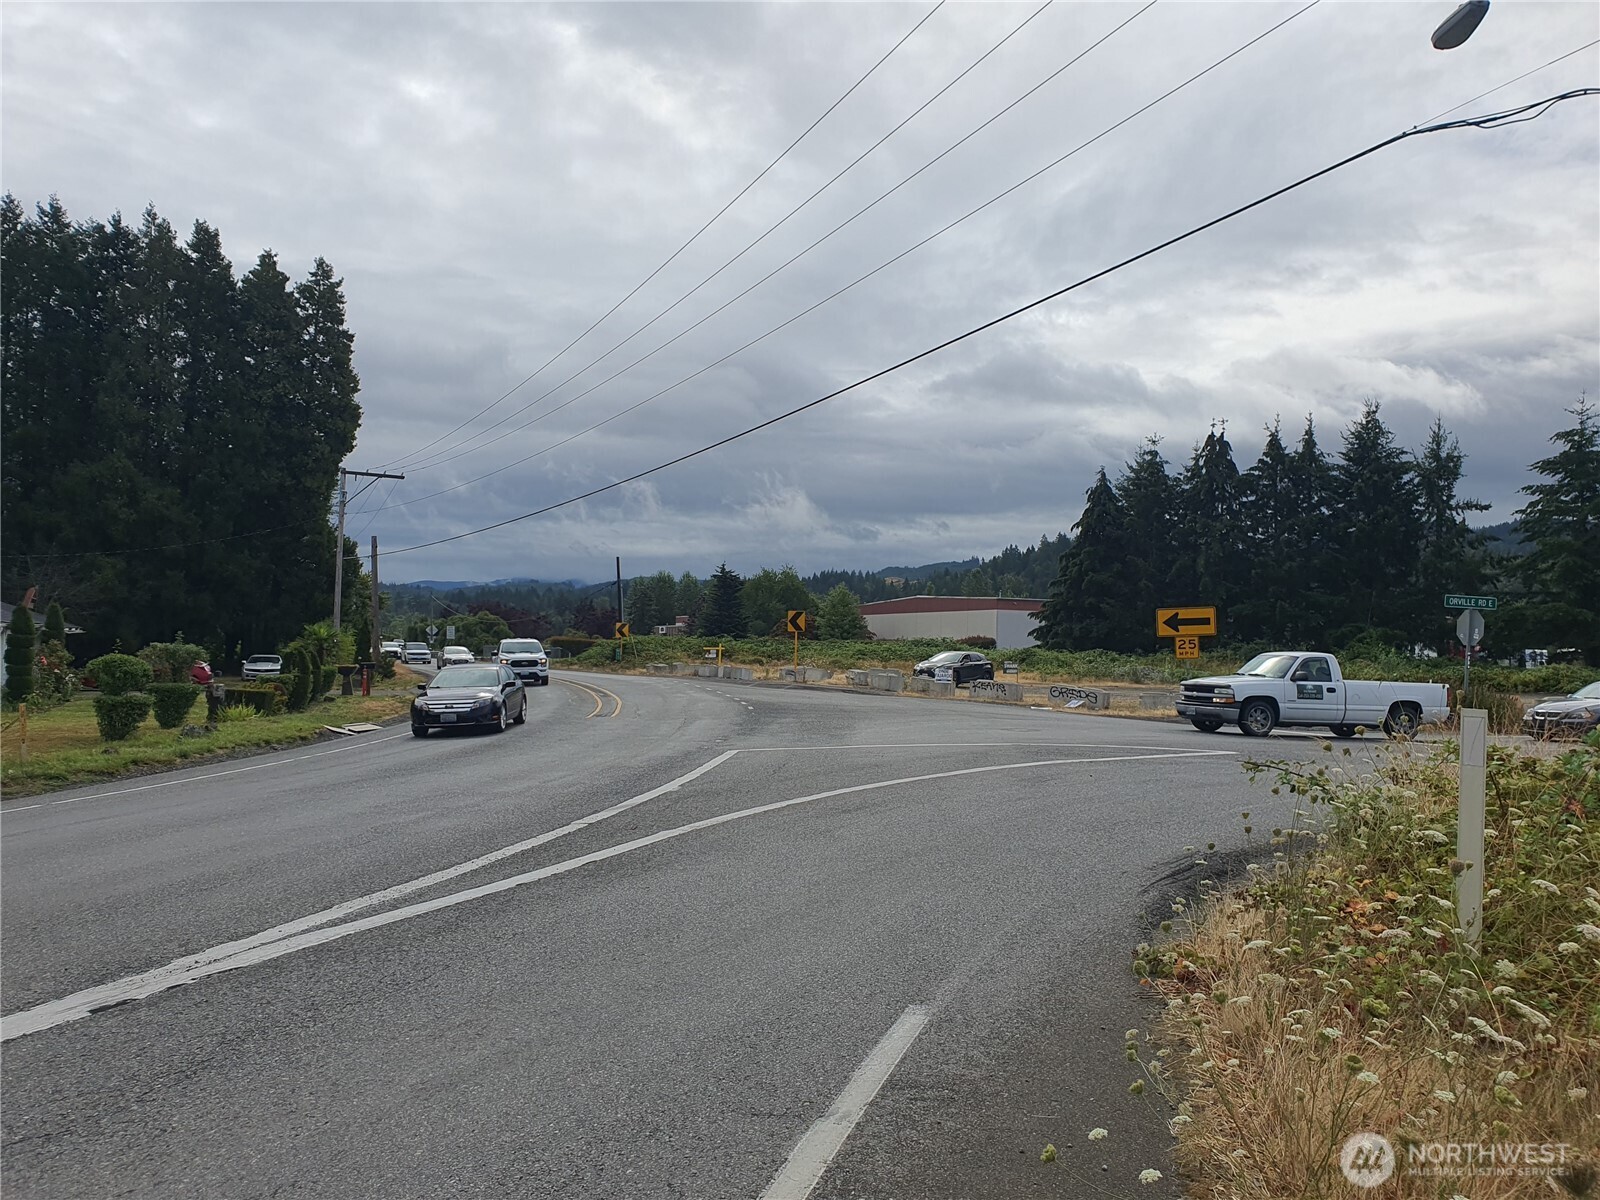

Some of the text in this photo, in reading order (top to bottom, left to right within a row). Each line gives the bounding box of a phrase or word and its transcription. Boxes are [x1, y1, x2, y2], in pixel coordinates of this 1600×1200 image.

[1449, 597, 1476, 606] ORVILLE
[1478, 599, 1487, 607] RD
[1177, 638, 1197, 650] 25
